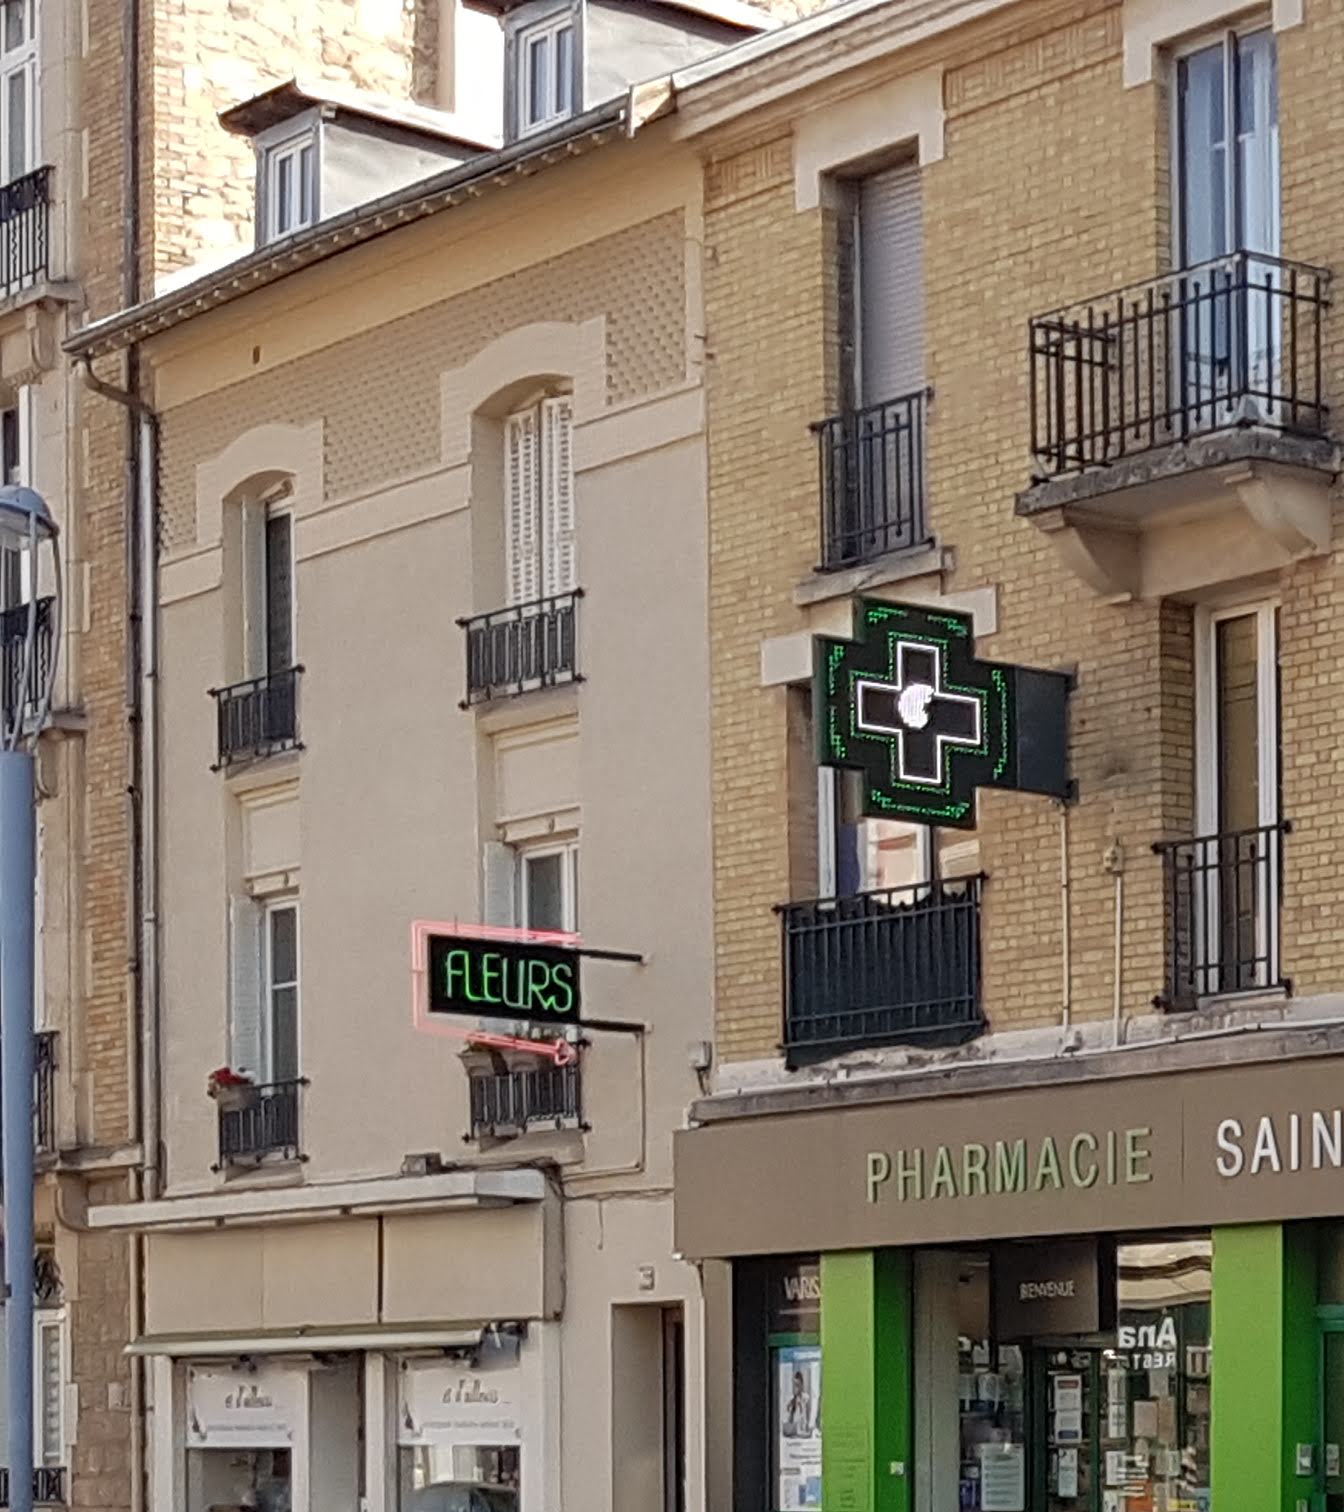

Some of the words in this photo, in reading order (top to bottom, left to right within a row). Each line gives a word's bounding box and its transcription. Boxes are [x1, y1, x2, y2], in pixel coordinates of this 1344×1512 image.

[445, 950, 573, 1013] FLEURS
[865, 1127, 1154, 1203] PHARMACIE
[639, 1265, 656, 1291] 3
